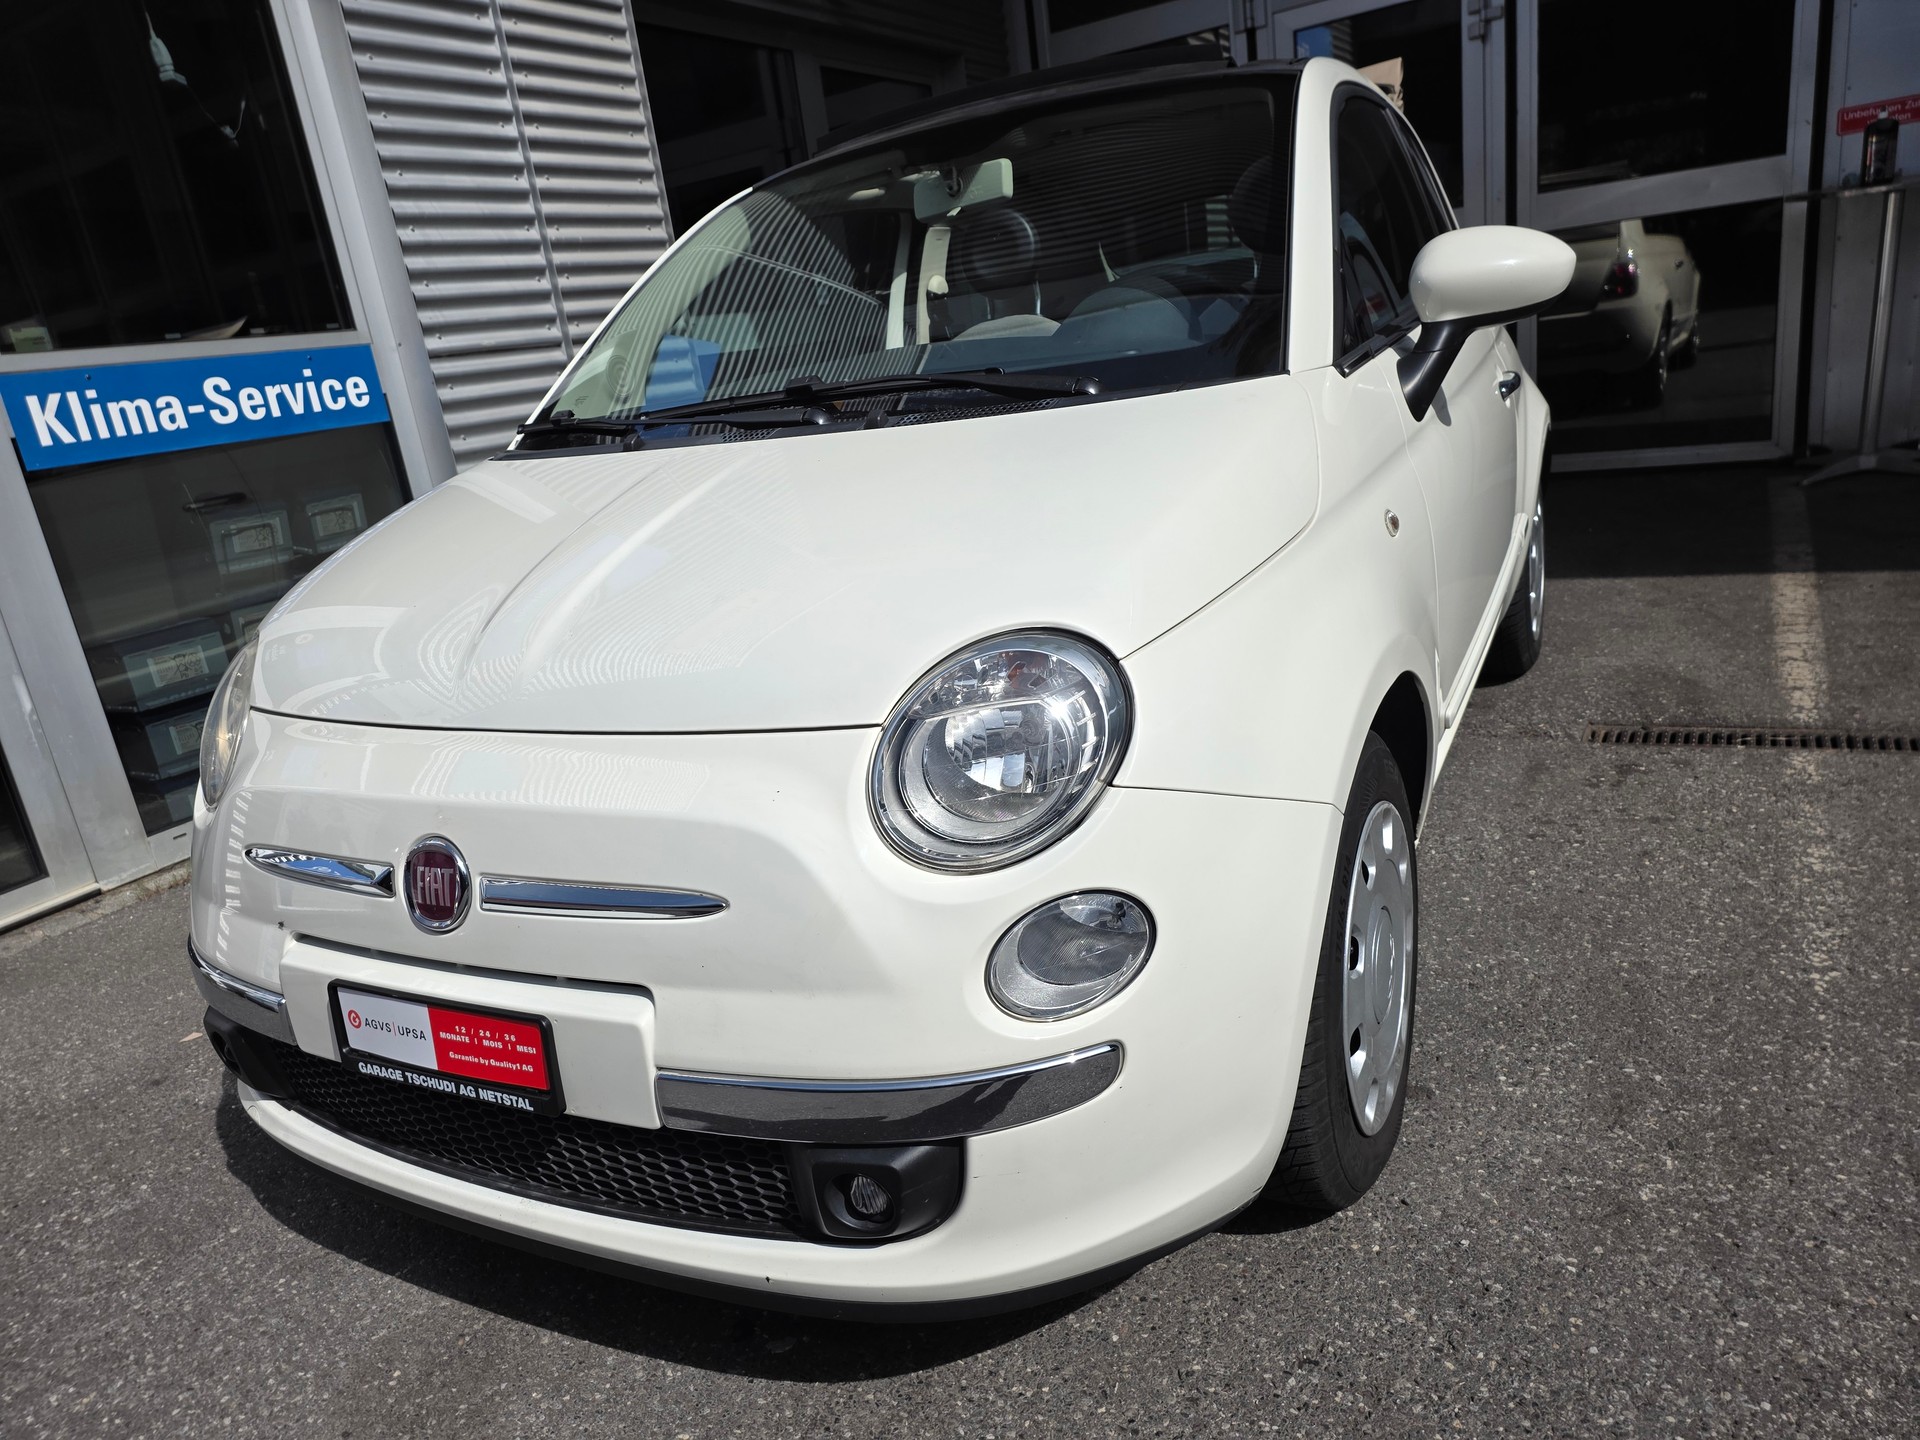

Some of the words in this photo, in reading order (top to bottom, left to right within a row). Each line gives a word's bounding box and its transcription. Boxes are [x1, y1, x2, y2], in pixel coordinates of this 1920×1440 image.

[1844, 105, 1901, 120] Unbefuen
[25, 368, 370, 447] Klima-Service
[416, 866, 454, 907] FIAT
[439, 1031, 470, 1043] MONATE
[482, 1039, 503, 1049] MOIS
[516, 1044, 537, 1054] MESI
[455, 1025, 466, 1033] 12
[479, 1029, 491, 1038] 24
[504, 1033, 516, 1042] 36
[449, 1051, 479, 1063] Garantie
[479, 1057, 489, 1066] by
[490, 1059, 521, 1070] Quality1
[522, 1064, 534, 1072] AG
[358, 1062, 404, 1082] GARAGE
[405, 1072, 456, 1094] TSCHUDI
[459, 1085, 476, 1098] AG
[479, 1088, 534, 1111] NETSTAL
